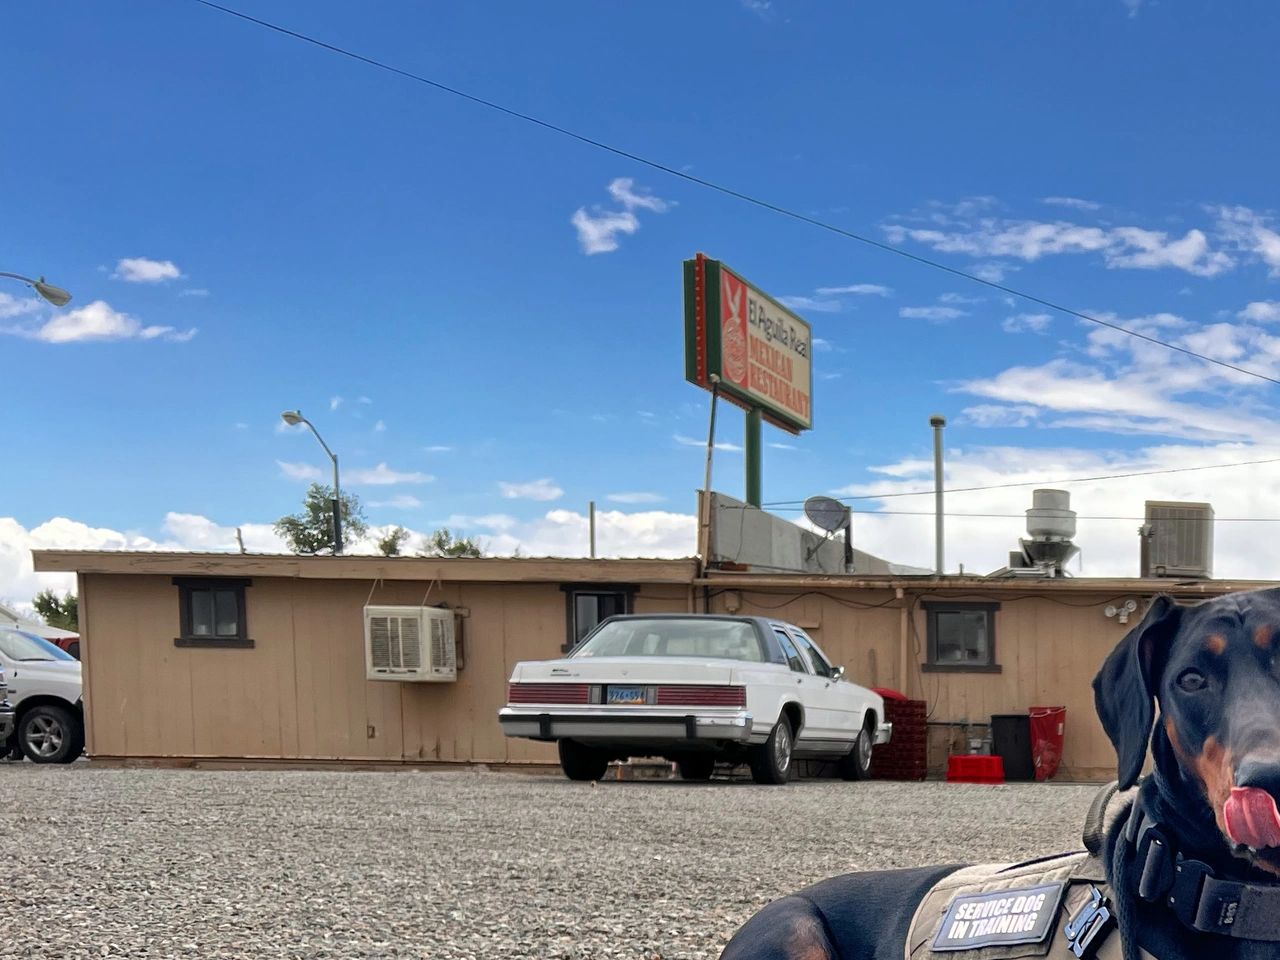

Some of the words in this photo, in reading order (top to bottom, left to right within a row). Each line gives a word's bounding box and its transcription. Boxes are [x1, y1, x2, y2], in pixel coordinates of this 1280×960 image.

[749, 298, 757, 325] El
[758, 304, 788, 345] Aguila
[750, 336, 792, 382] MEXICAN
[750, 361, 809, 418] RESTAURANT
[948, 919, 969, 939] IN
[969, 913, 1038, 938] TRAINING
[955, 898, 1014, 920] SERVICE
[1012, 893, 1045, 913] DOG
